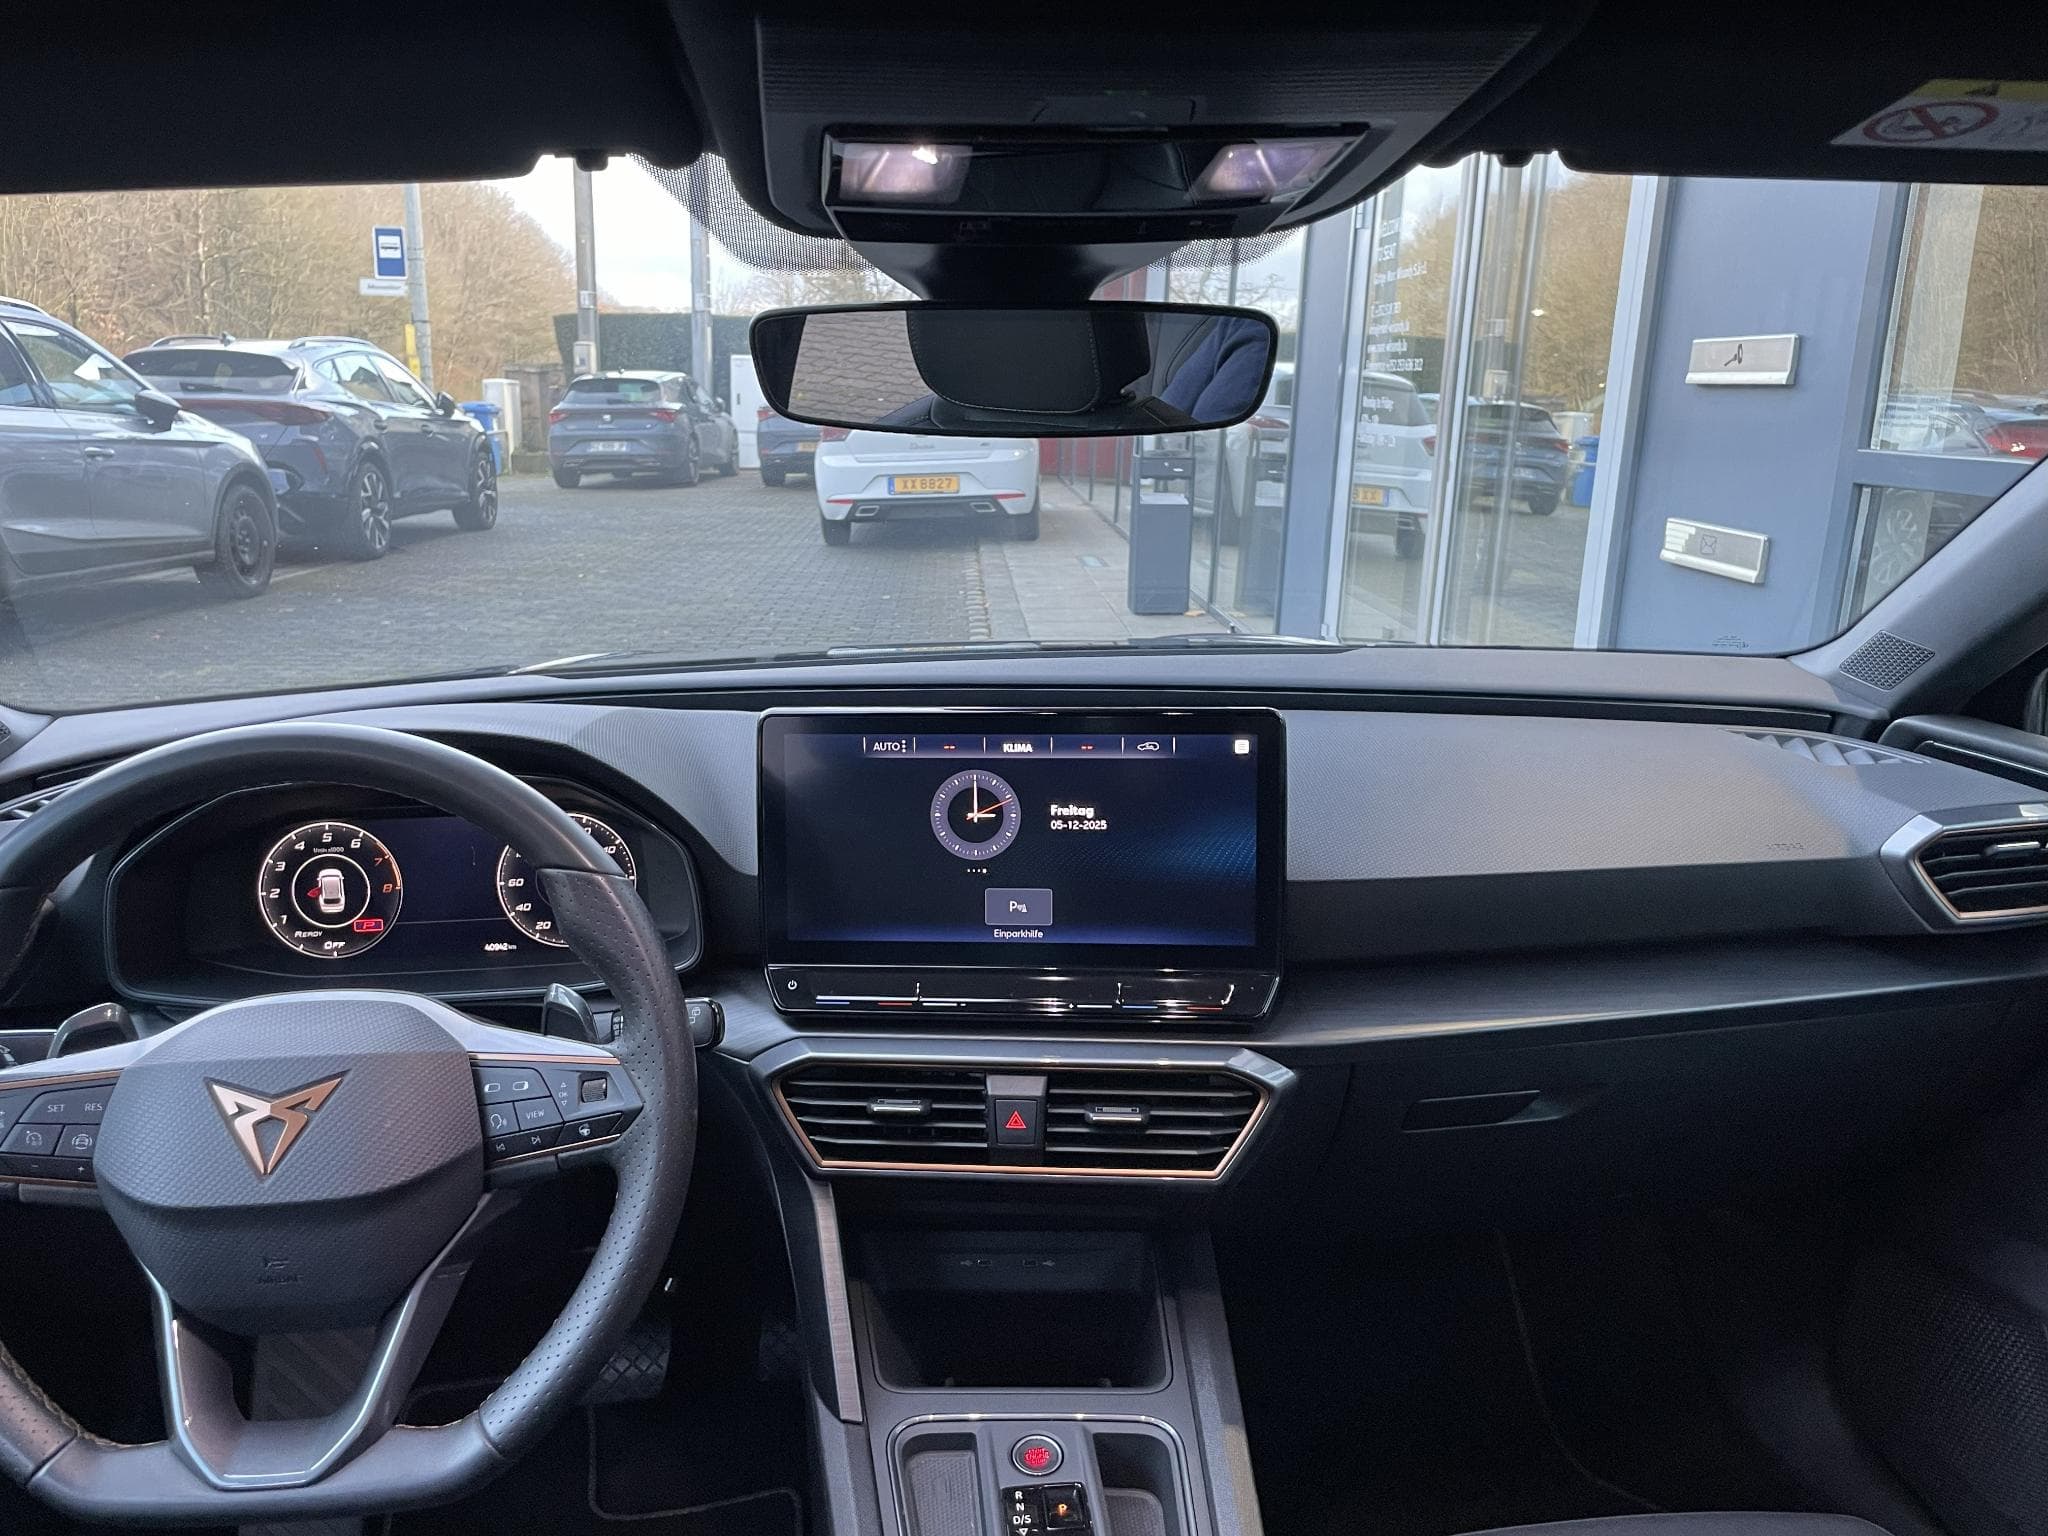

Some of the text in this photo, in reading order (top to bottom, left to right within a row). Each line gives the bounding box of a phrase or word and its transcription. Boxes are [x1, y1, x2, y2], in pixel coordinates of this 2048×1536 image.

[902, 477, 953, 490] XX 8827
[873, 741, 901, 752] AUTO
[1003, 742, 1033, 753] KLIMA
[1050, 804, 1095, 819] Freitag
[1050, 820, 1107, 831] 05-12-2025
[322, 833, 333, 843] 5
[294, 841, 305, 851] 4
[351, 838, 361, 849] 6
[275, 861, 286, 871] 3
[374, 857, 383, 866] 7
[508, 878, 524, 887] 60
[269, 888, 280, 898] 2
[382, 883, 393, 893] 8
[515, 903, 531, 911] 40
[280, 915, 287, 924] 1
[535, 921, 551, 930] 20
[993, 928, 1044, 940] Einparkhilfe
[324, 941, 345, 950] OFF
[47, 1104, 65, 1113] SET
[85, 1103, 103, 1111] RES
[526, 1109, 545, 1119] VIEW
[1015, 1491, 1023, 1500] R
[1016, 1503, 1025, 1511] N
[1058, 1503, 1068, 1516] P
[1013, 1514, 1032, 1525] D/S
